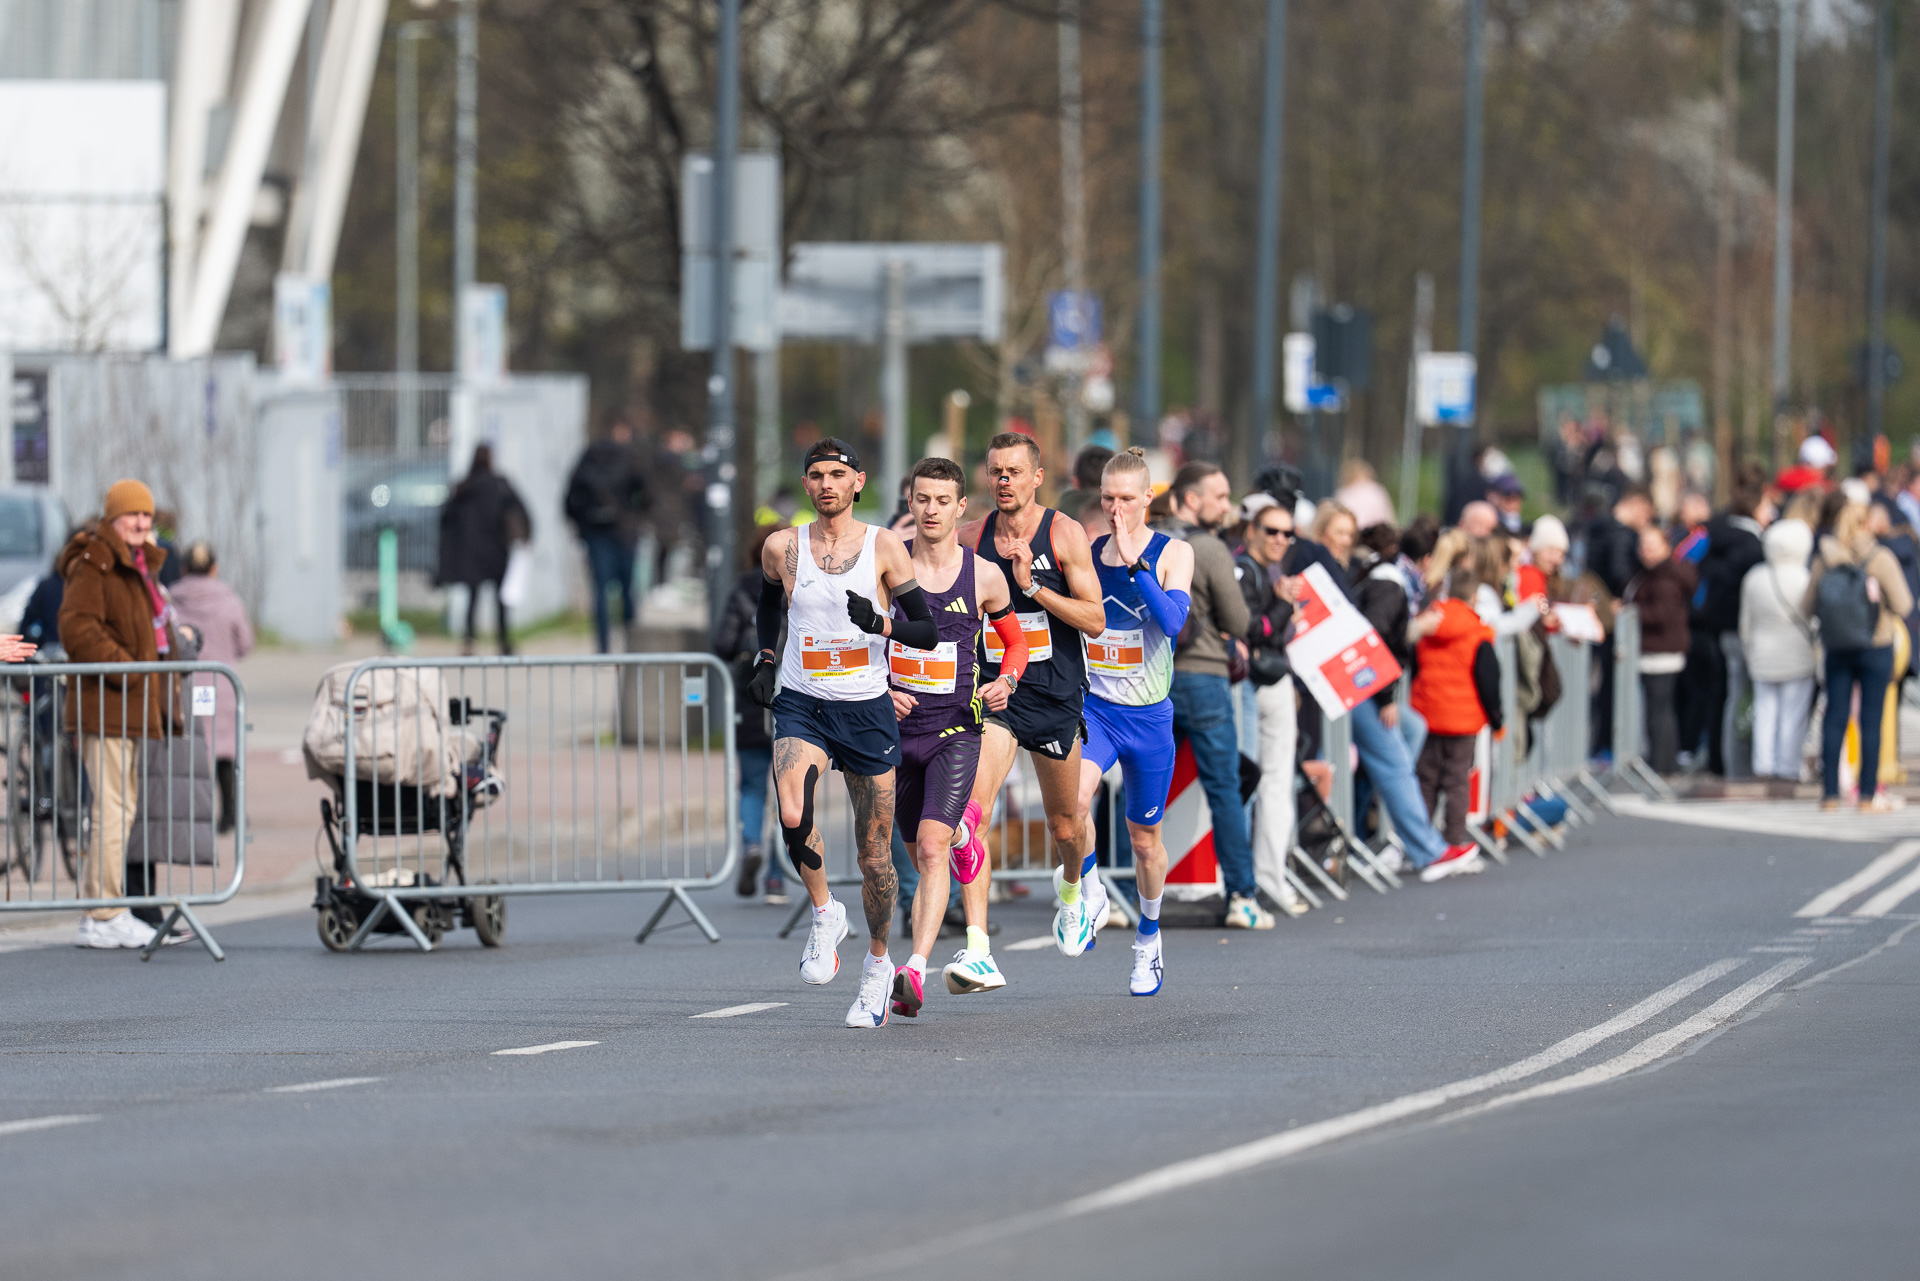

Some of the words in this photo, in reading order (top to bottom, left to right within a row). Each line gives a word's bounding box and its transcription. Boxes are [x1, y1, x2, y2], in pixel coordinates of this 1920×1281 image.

[830, 651, 840, 665] 5
[1102, 646, 1118, 660] 10
[918, 661, 924, 674] 1
